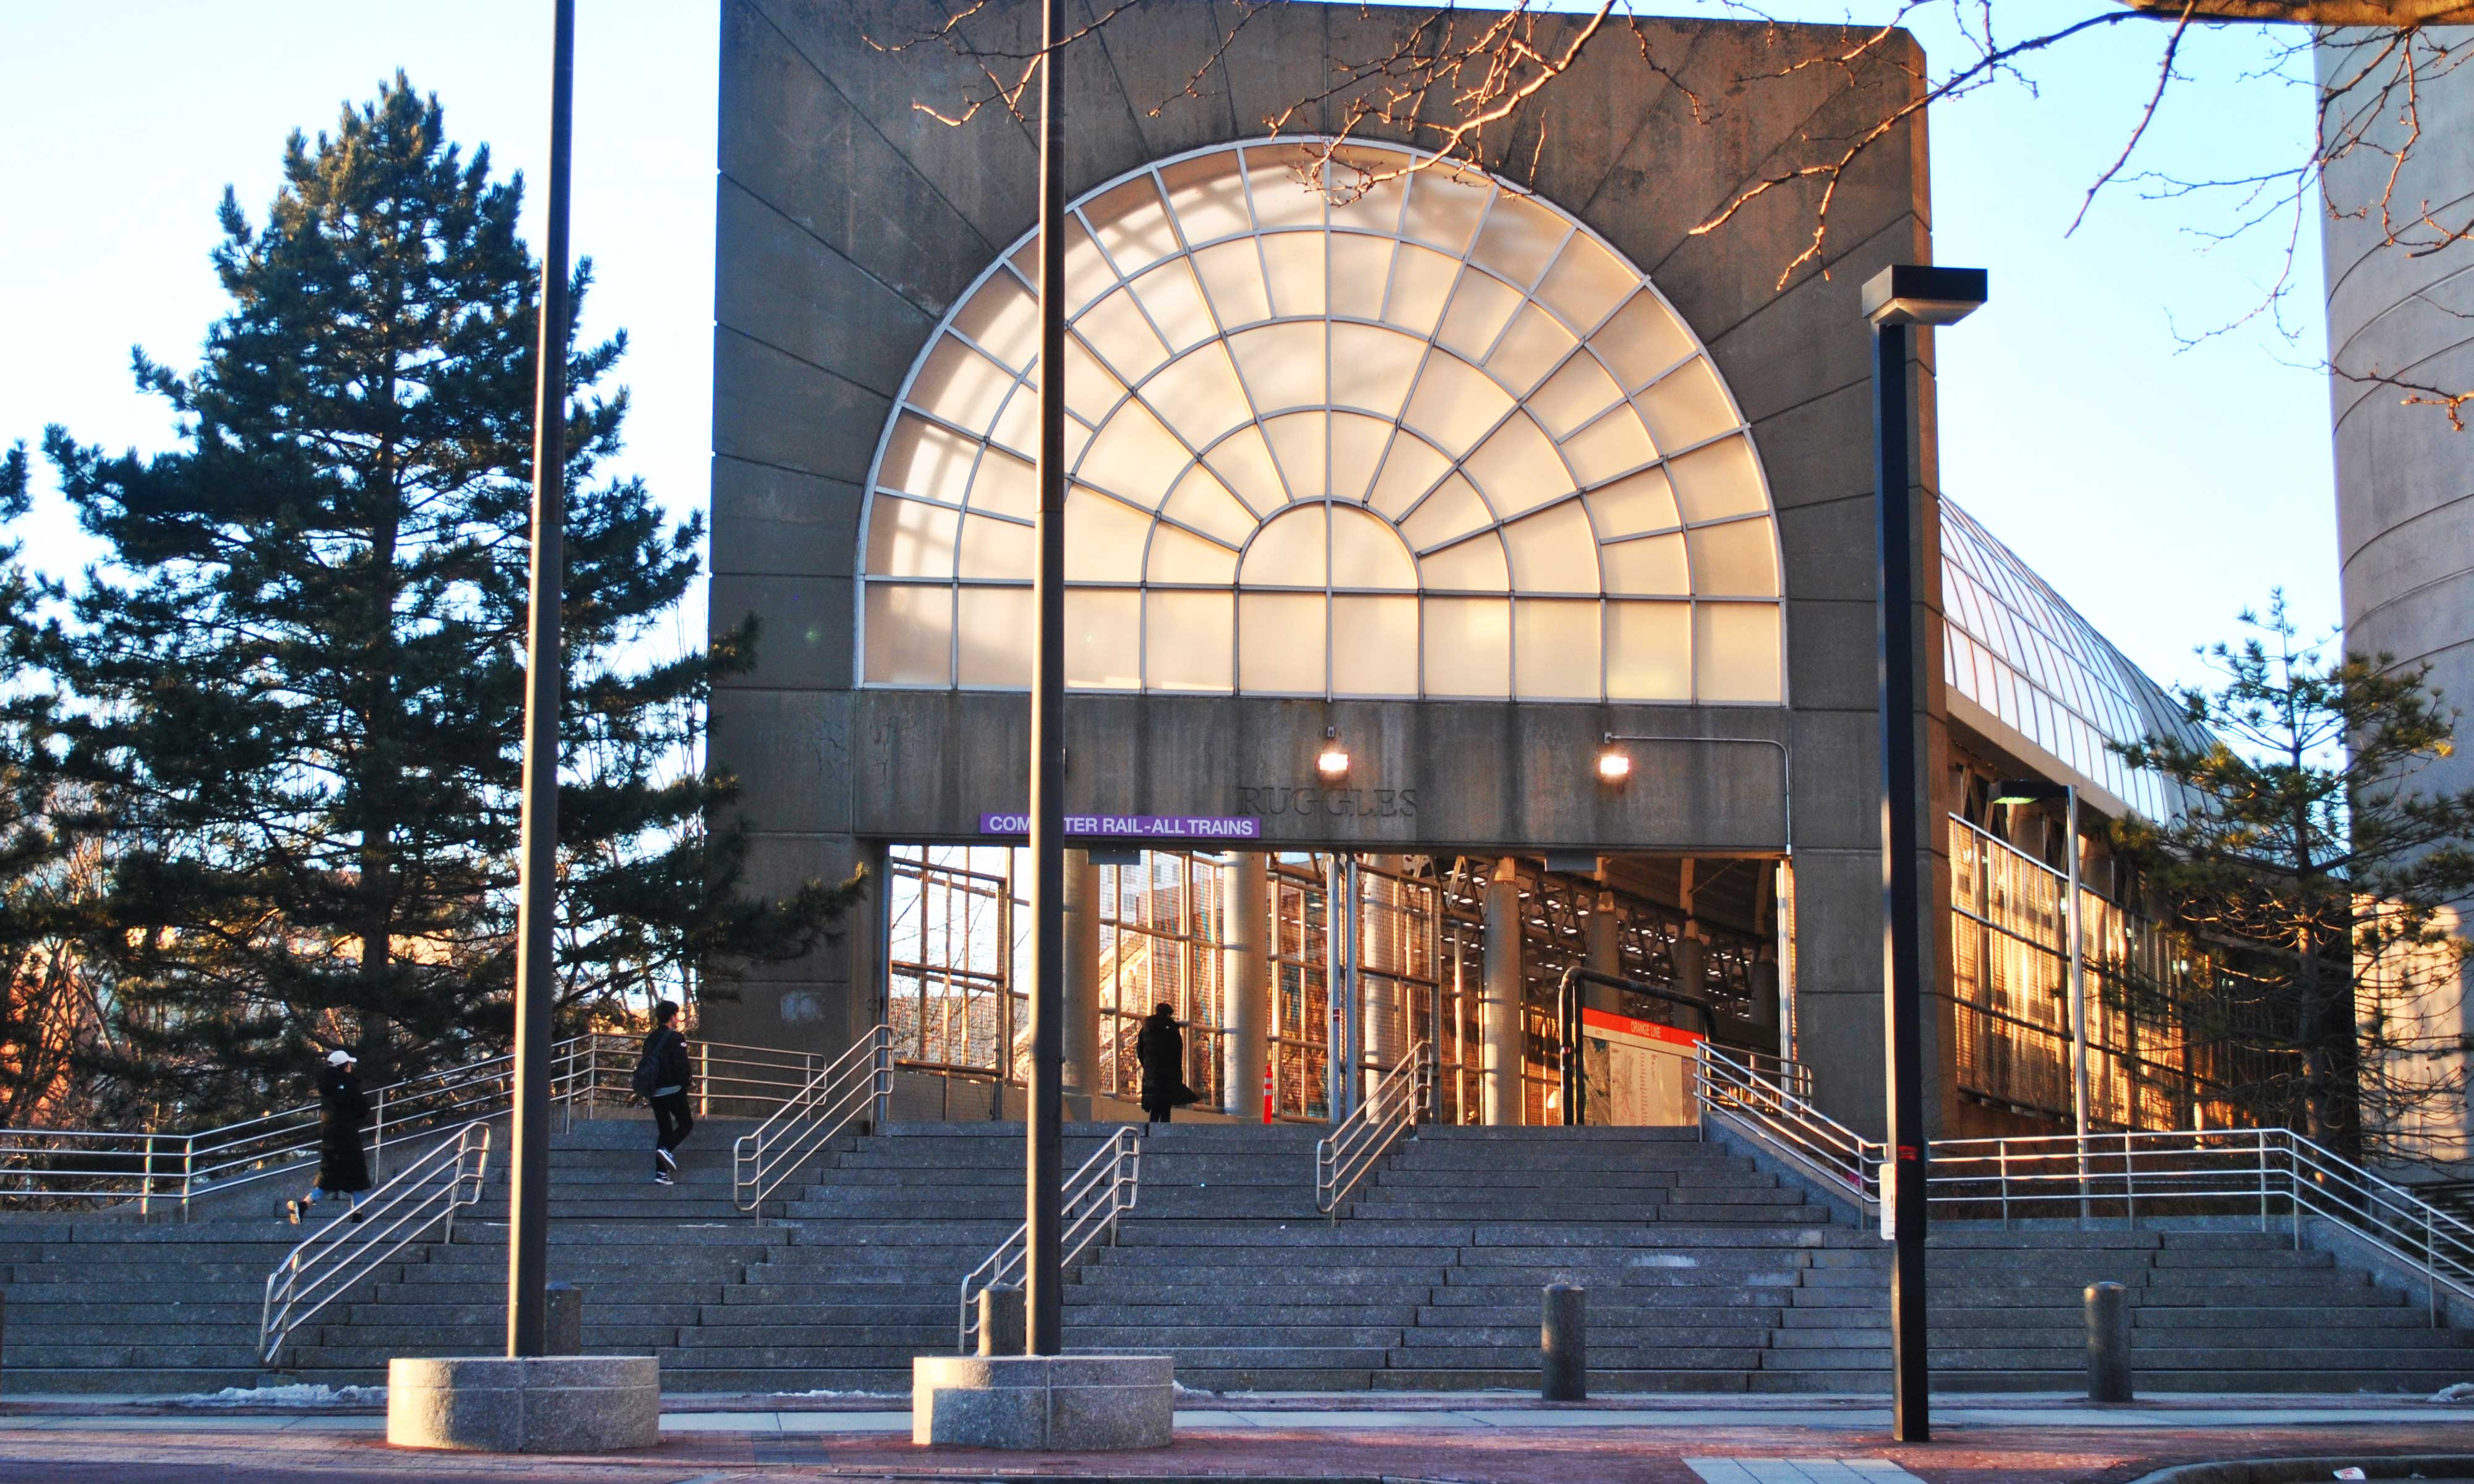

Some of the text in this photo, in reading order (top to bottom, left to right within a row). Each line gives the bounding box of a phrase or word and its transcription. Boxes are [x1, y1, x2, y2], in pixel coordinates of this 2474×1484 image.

[1238, 787, 1417, 817] RUGGLES
[989, 816, 1098, 833] COMTER
[1187, 819, 1253, 835] TRAINS
[1630, 1020, 1661, 1038] ORANGE LINE
